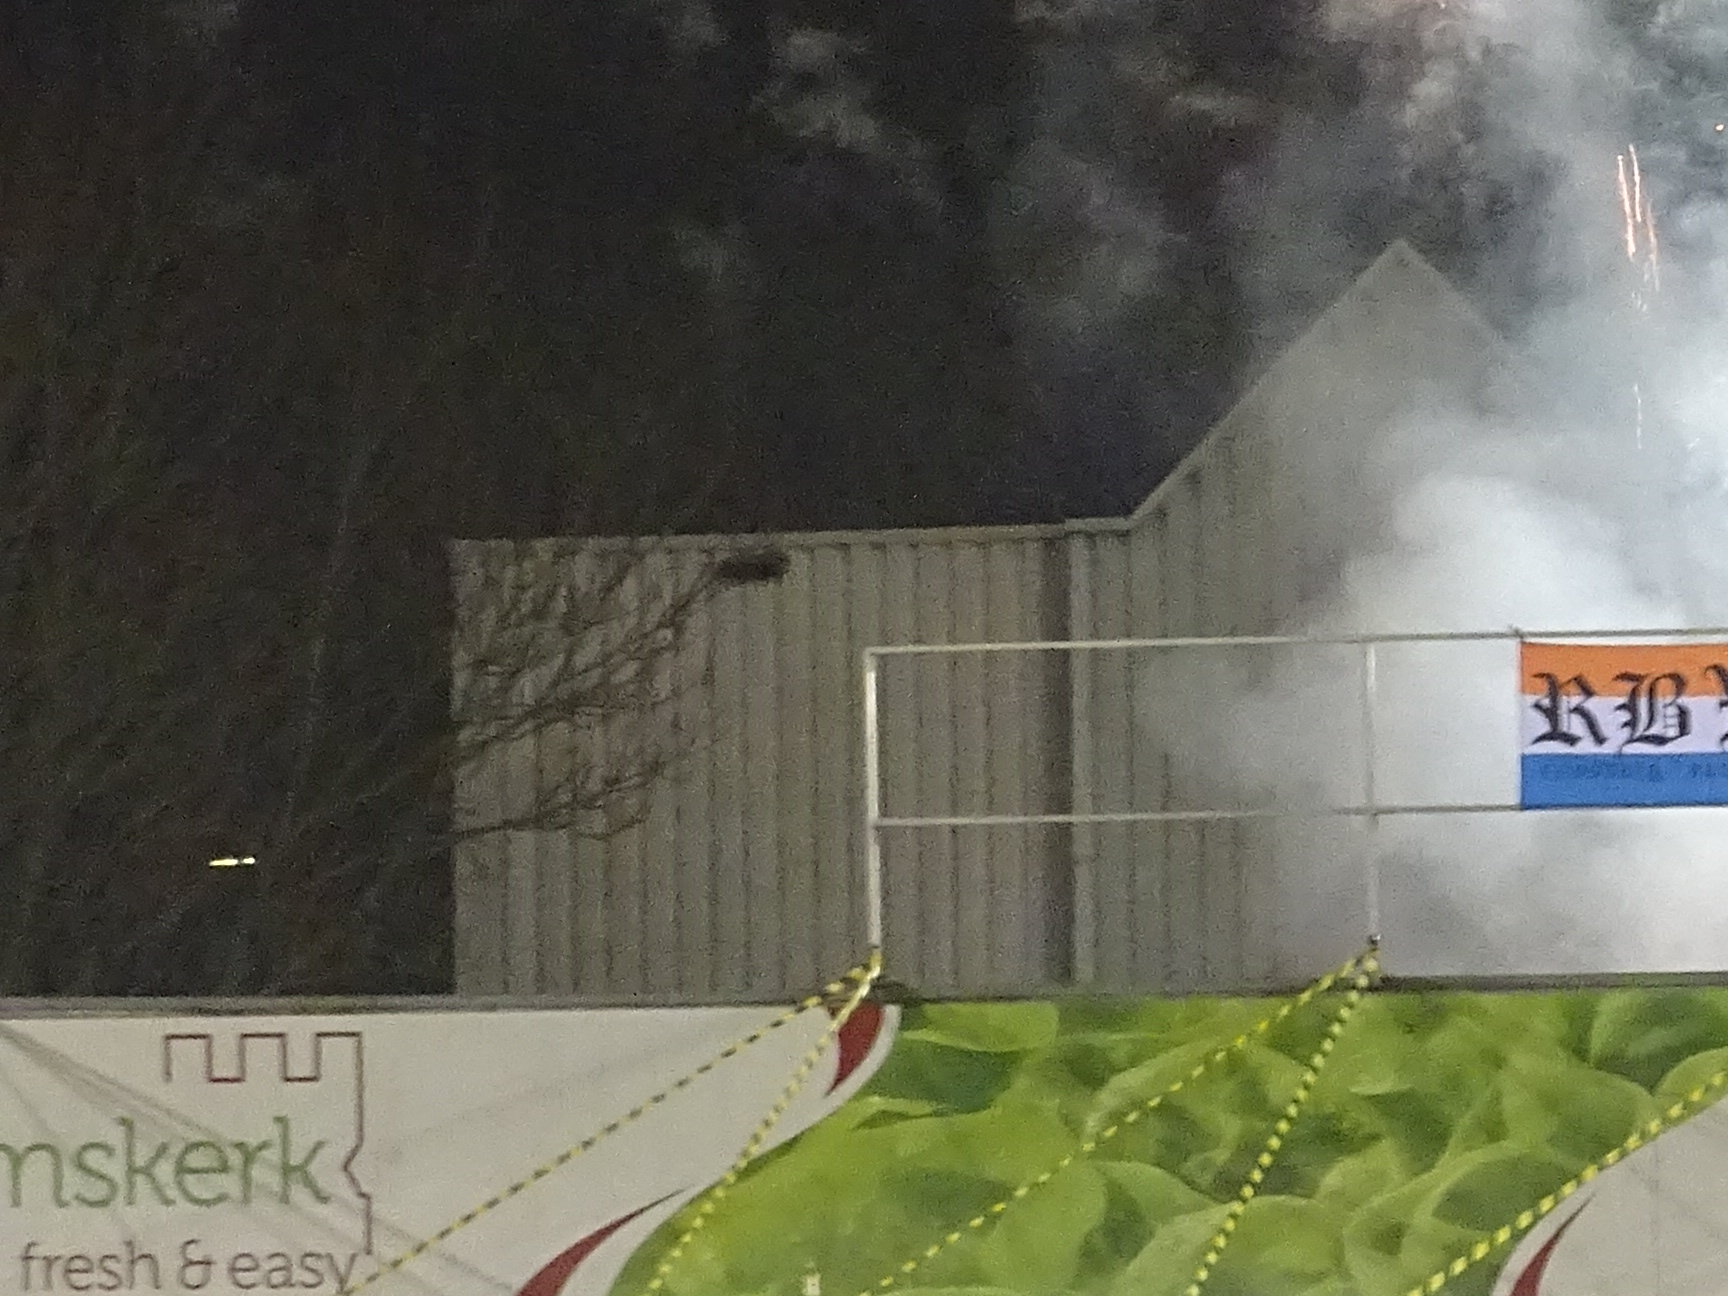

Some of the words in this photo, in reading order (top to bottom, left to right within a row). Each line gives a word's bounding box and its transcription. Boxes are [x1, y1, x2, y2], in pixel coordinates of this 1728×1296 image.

[0, 1114, 332, 1208] mskerk
[20, 1239, 162, 1292] fresh
[179, 1238, 216, 1291] &
